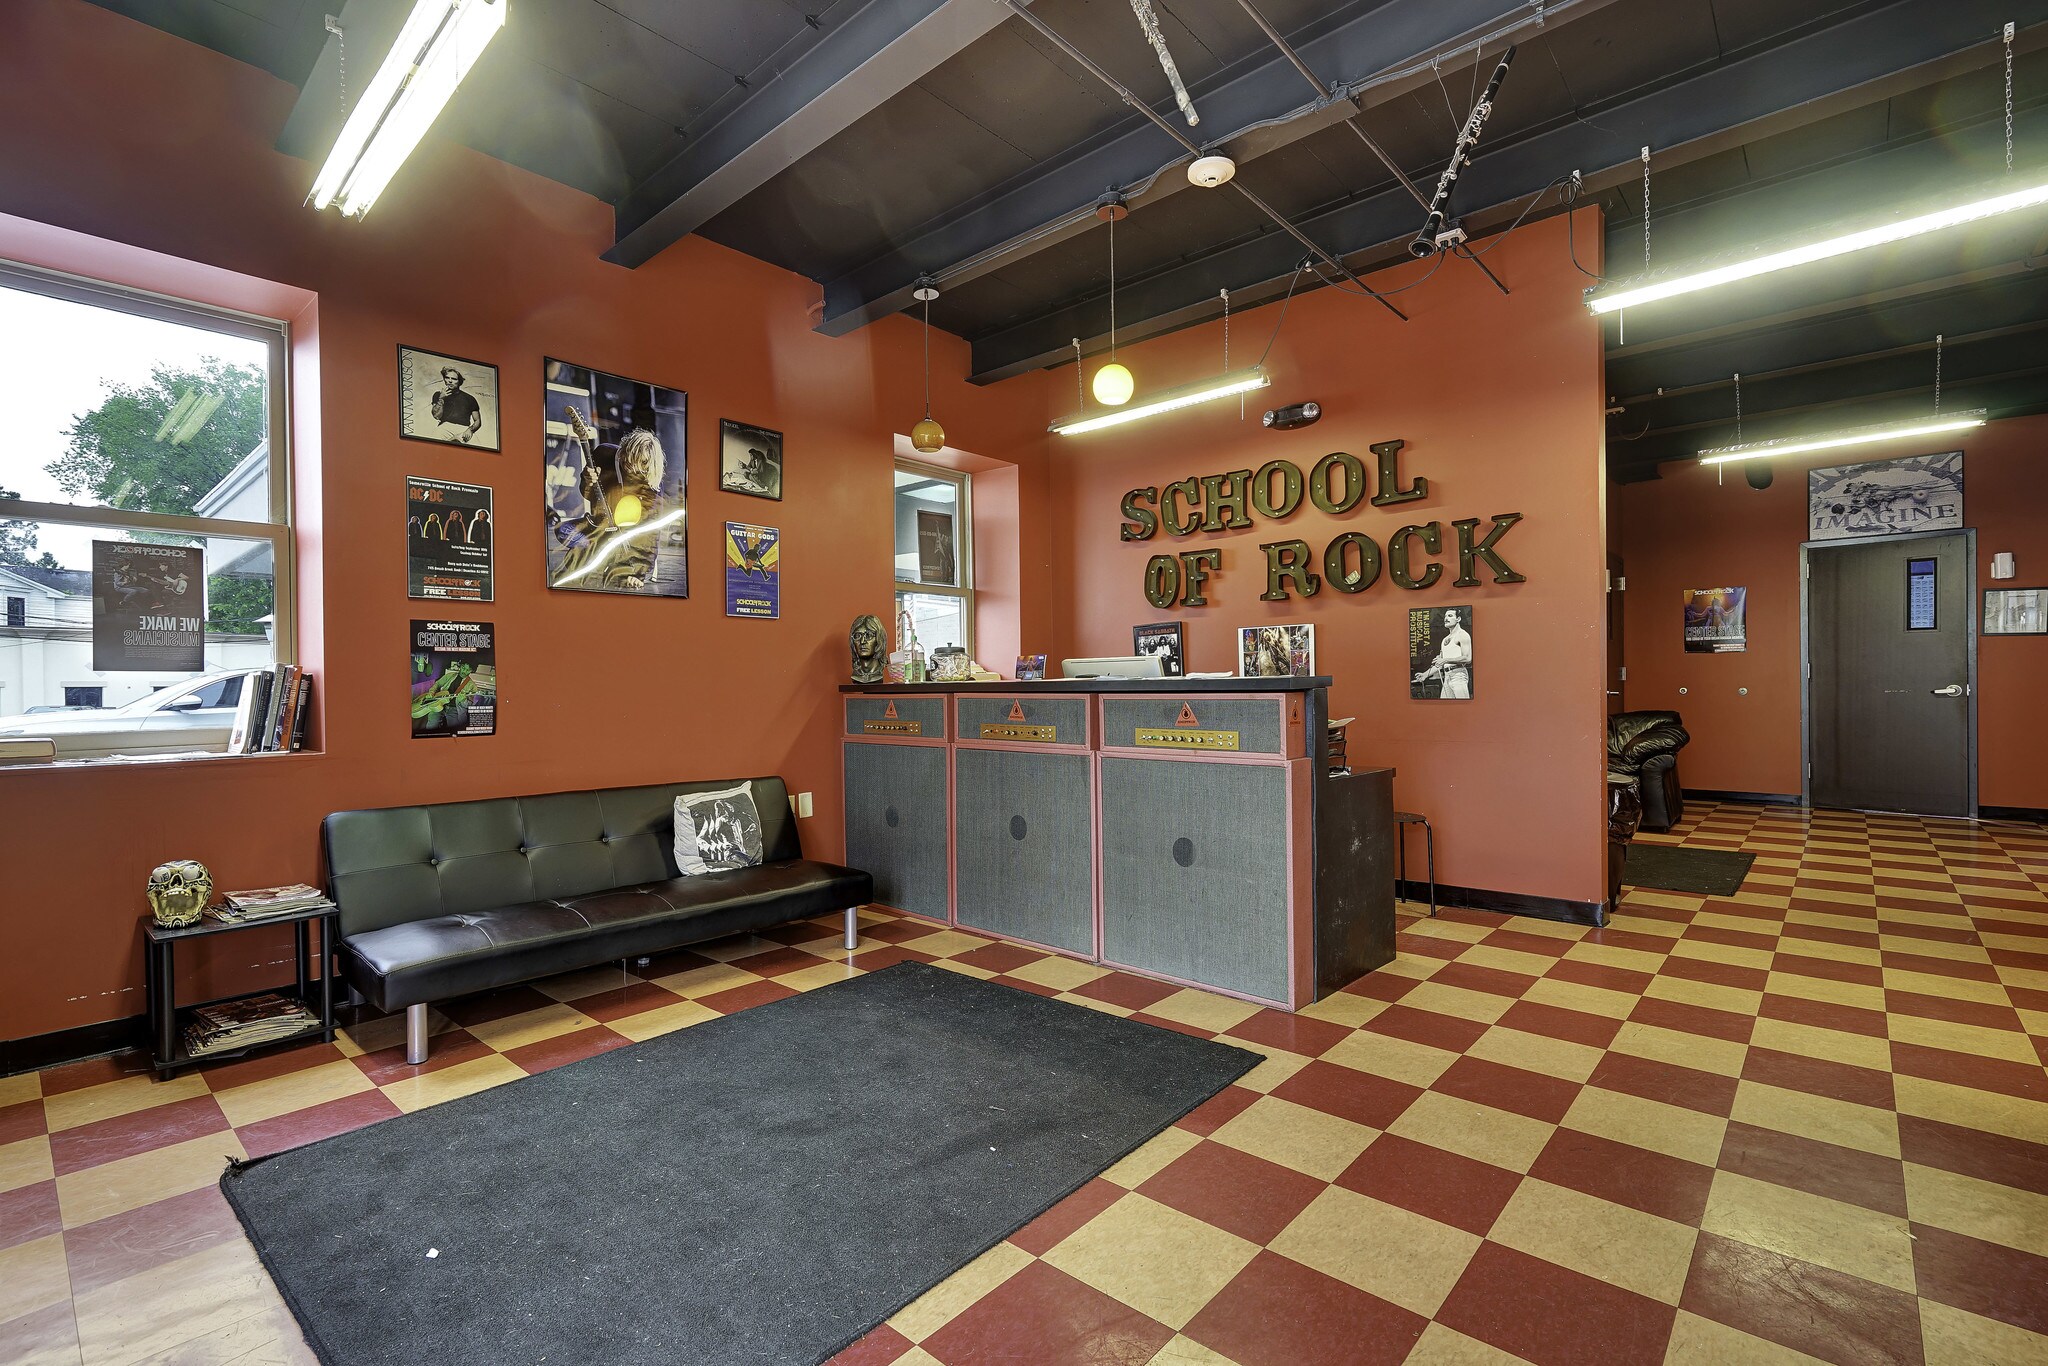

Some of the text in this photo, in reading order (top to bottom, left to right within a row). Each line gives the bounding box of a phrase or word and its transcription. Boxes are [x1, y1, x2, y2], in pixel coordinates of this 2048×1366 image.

[402, 350, 414, 434] VAN MORRISON
[1120, 439, 1429, 542] SCHOOL
[1813, 504, 1958, 530] IMAGINE
[730, 530, 755, 538] GUITAR
[1144, 512, 1527, 609] OF ROCK
[417, 632, 491, 648] CENTER STAGE
[1416, 611, 1424, 643] MUSICAL
[1686, 626, 1716, 637] CENTER
